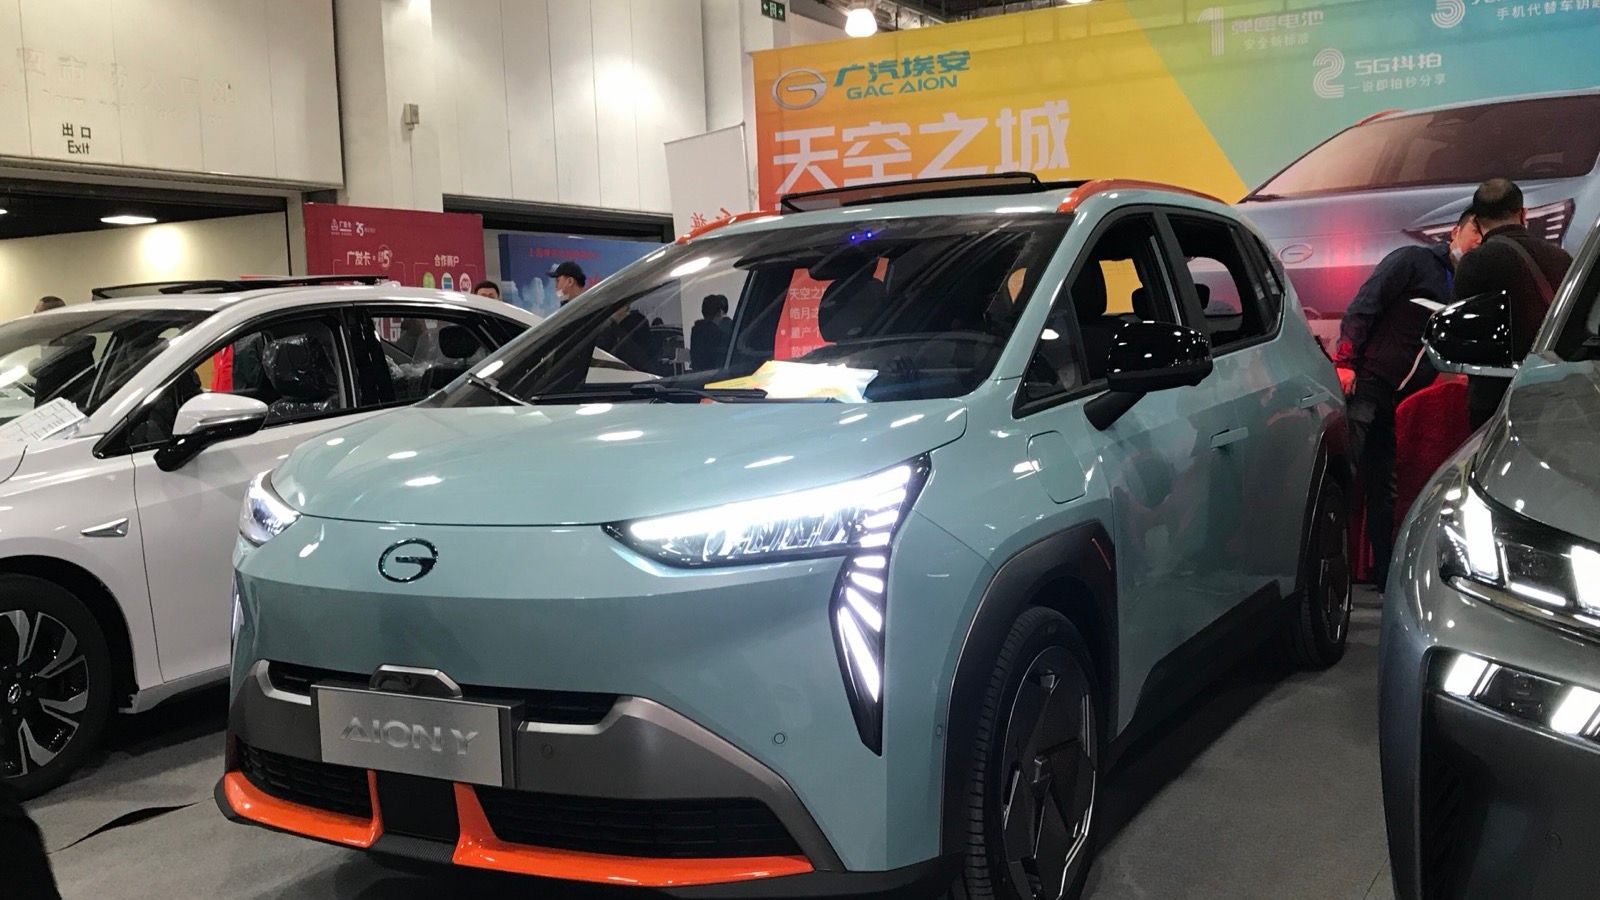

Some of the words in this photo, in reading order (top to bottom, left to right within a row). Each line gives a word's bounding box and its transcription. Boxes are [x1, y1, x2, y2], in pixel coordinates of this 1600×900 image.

[1231, 10, 1324, 34] 弹匣电池
[834, 50, 970, 88] 广汽埃安
[1312, 48, 1345, 99] 2
[1354, 52, 1443, 76] 5G抖拍
[846, 81, 893, 100] GAC
[899, 75, 958, 94] AION
[62, 122, 92, 140] 出口
[67, 140, 90, 155] Exit
[773, 99, 1070, 195] 天空之城
[789, 286, 826, 300] 天空之
[340, 716, 443, 752] AION
[450, 728, 479, 756] Y
